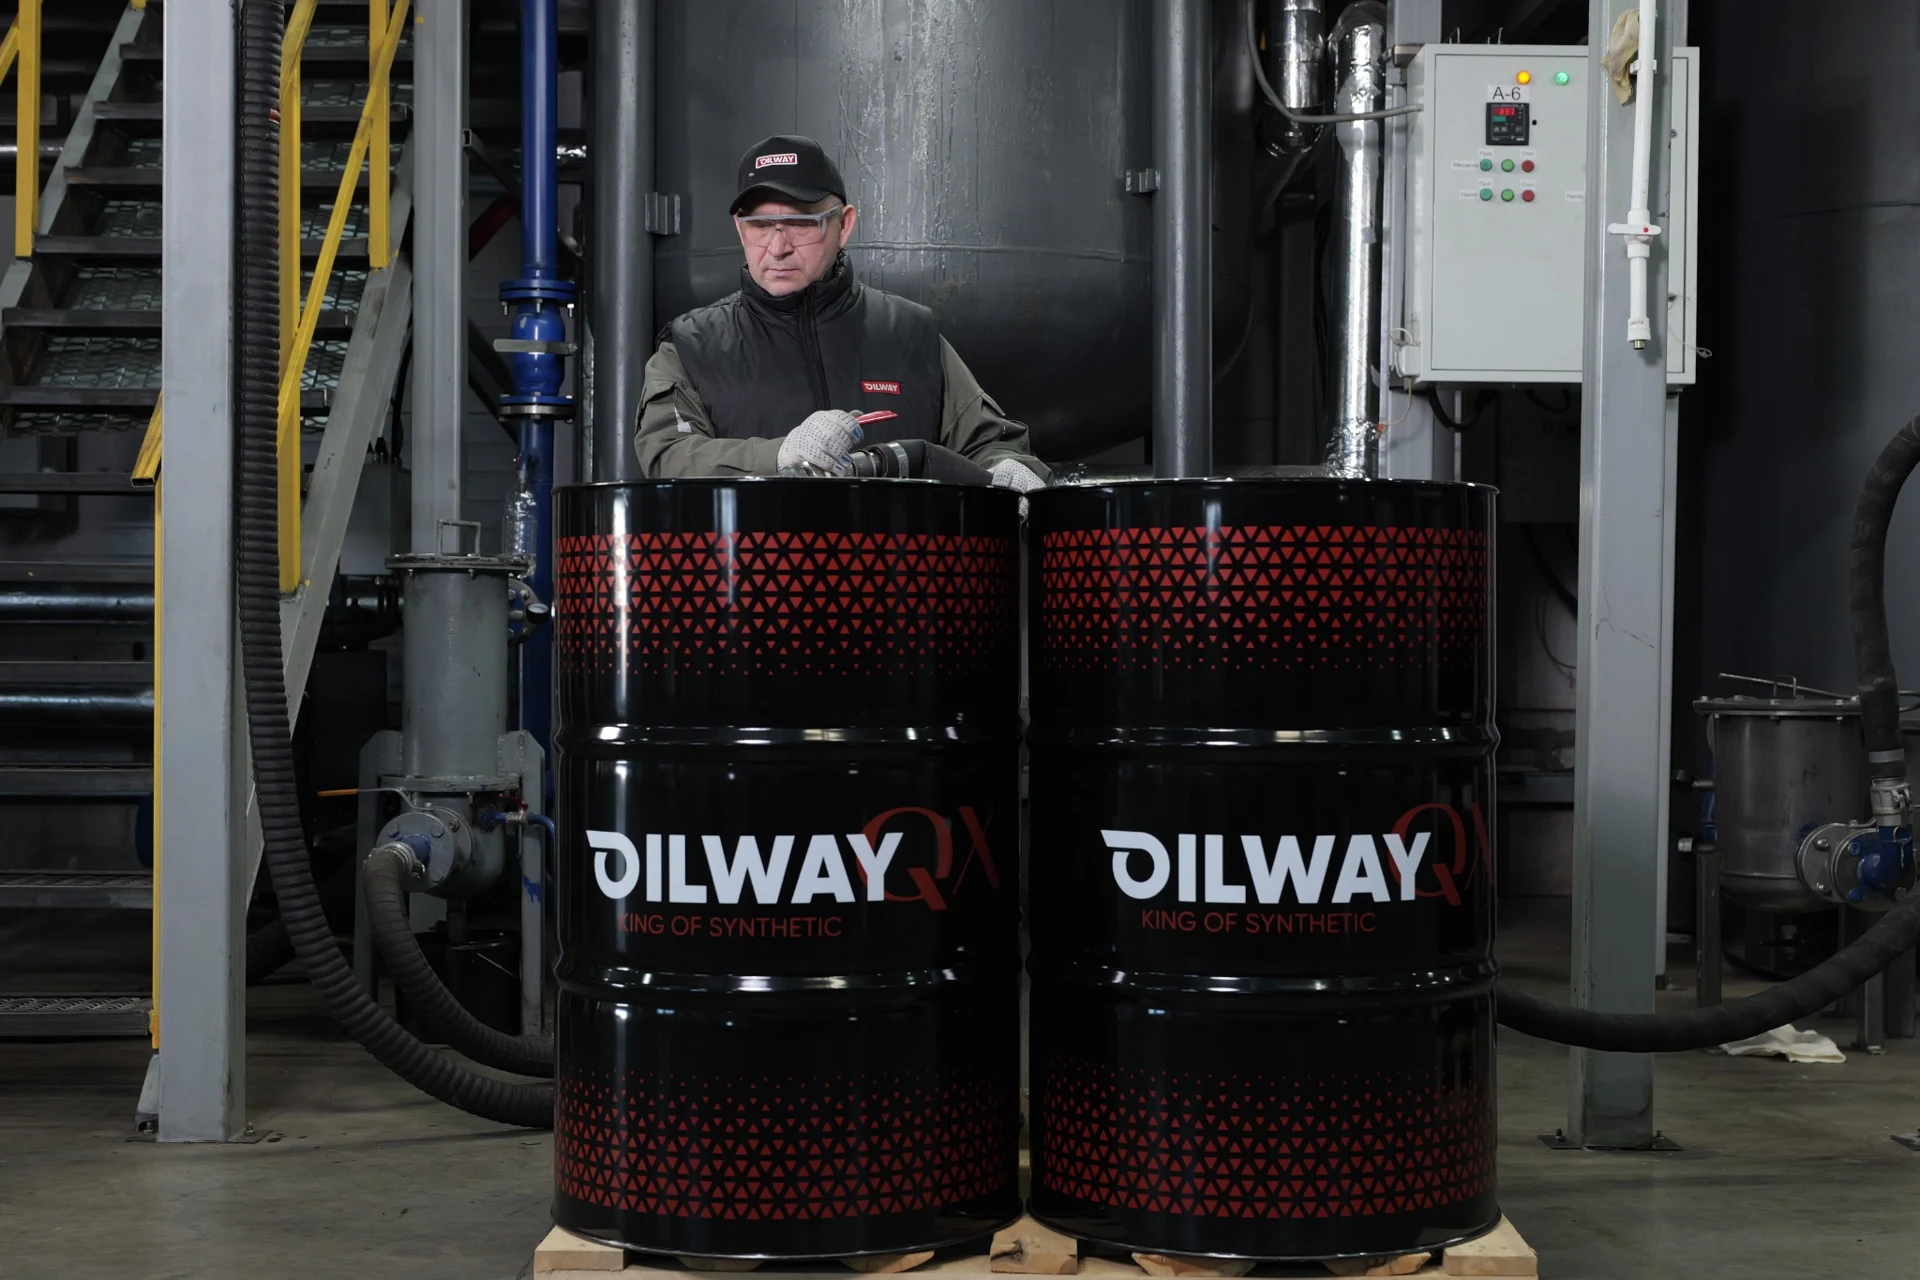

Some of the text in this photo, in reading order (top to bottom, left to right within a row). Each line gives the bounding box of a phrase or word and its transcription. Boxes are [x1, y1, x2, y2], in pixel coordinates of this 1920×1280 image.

[1492, 86, 1521, 101] A-6
[760, 155, 794, 165] OILWAY
[864, 383, 898, 392] OILWAY
[586, 830, 904, 905] OILWAY
[1100, 829, 1432, 905] OILWAY
[619, 912, 842, 938] KING OF SYNTHETIC
[1142, 909, 1376, 934] KING OF SYNTHETIC
